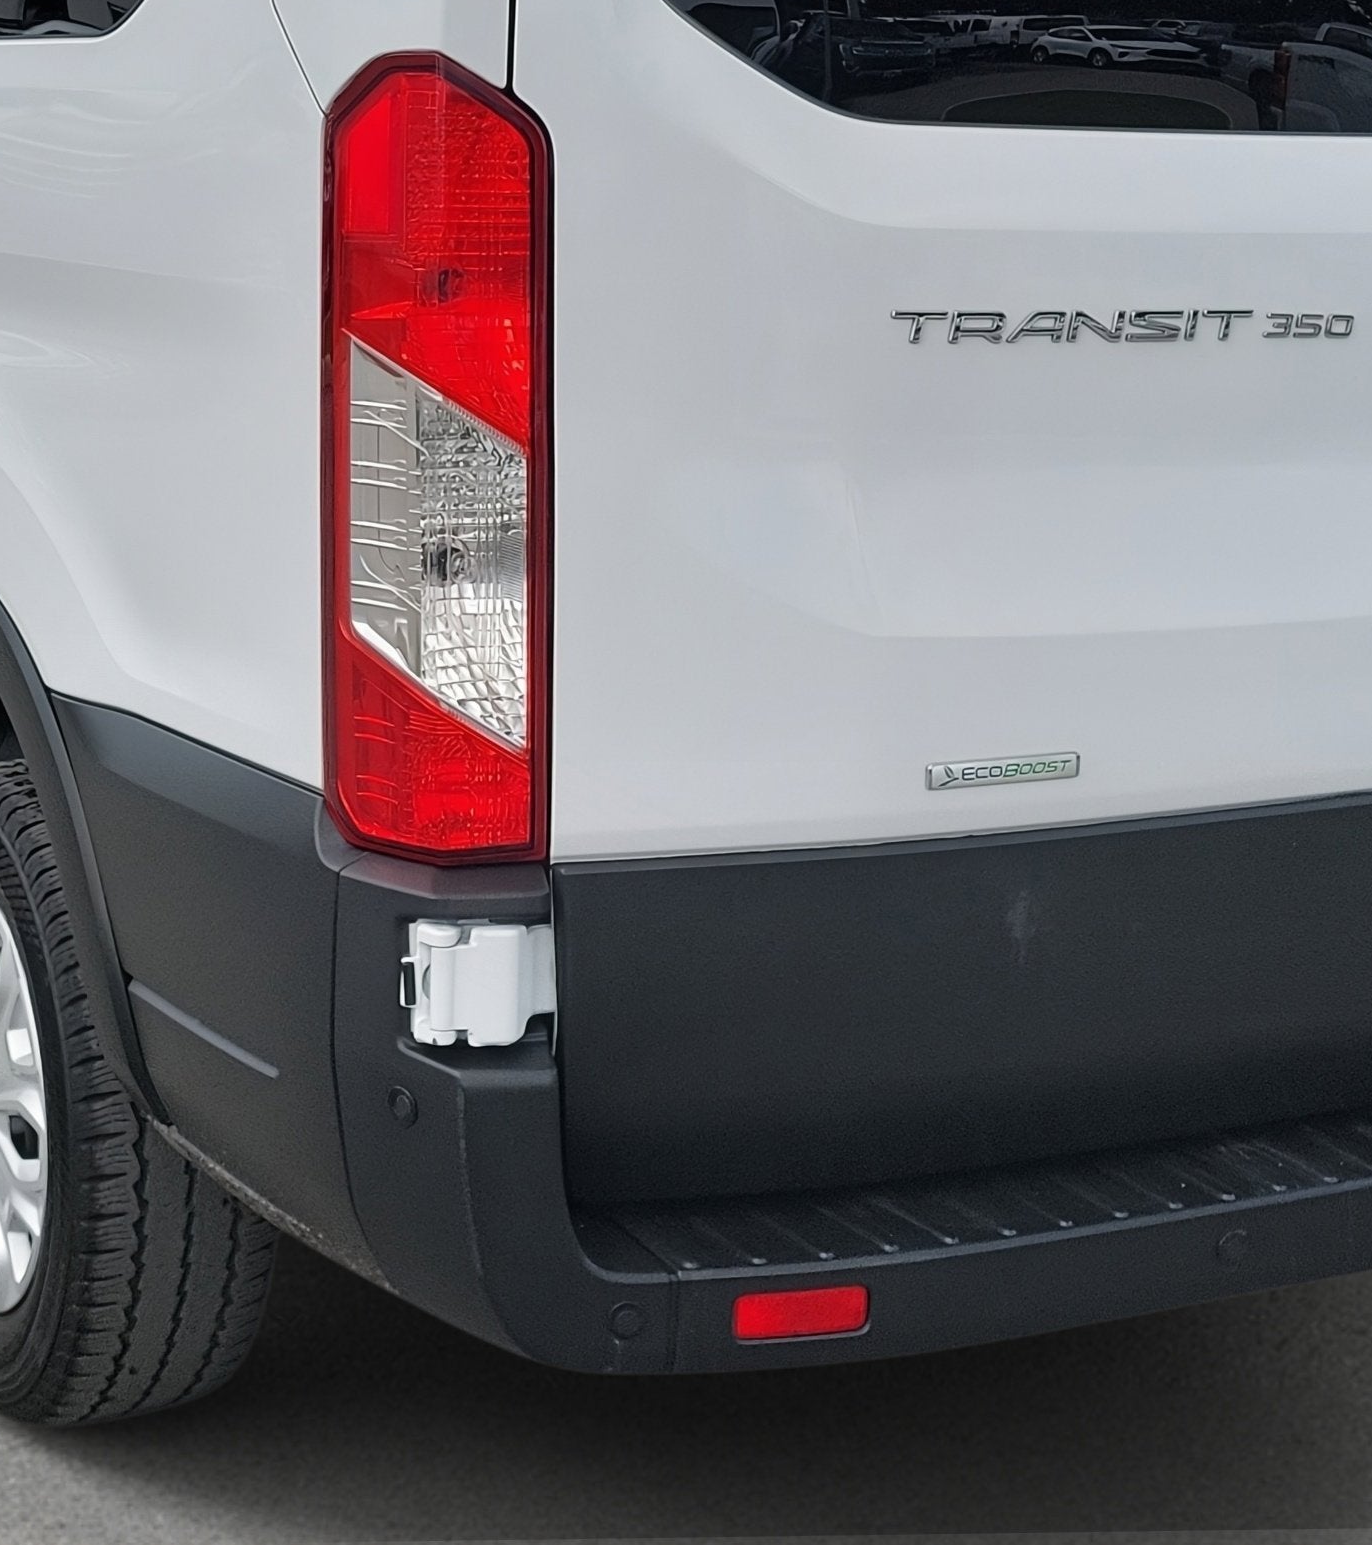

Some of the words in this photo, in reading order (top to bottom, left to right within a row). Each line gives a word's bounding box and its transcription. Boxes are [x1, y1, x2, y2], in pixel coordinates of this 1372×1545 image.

[891, 310, 1254, 344] TRANSIT
[1263, 313, 1354, 339] 350
[962, 759, 1072, 781] ECOBOOST
